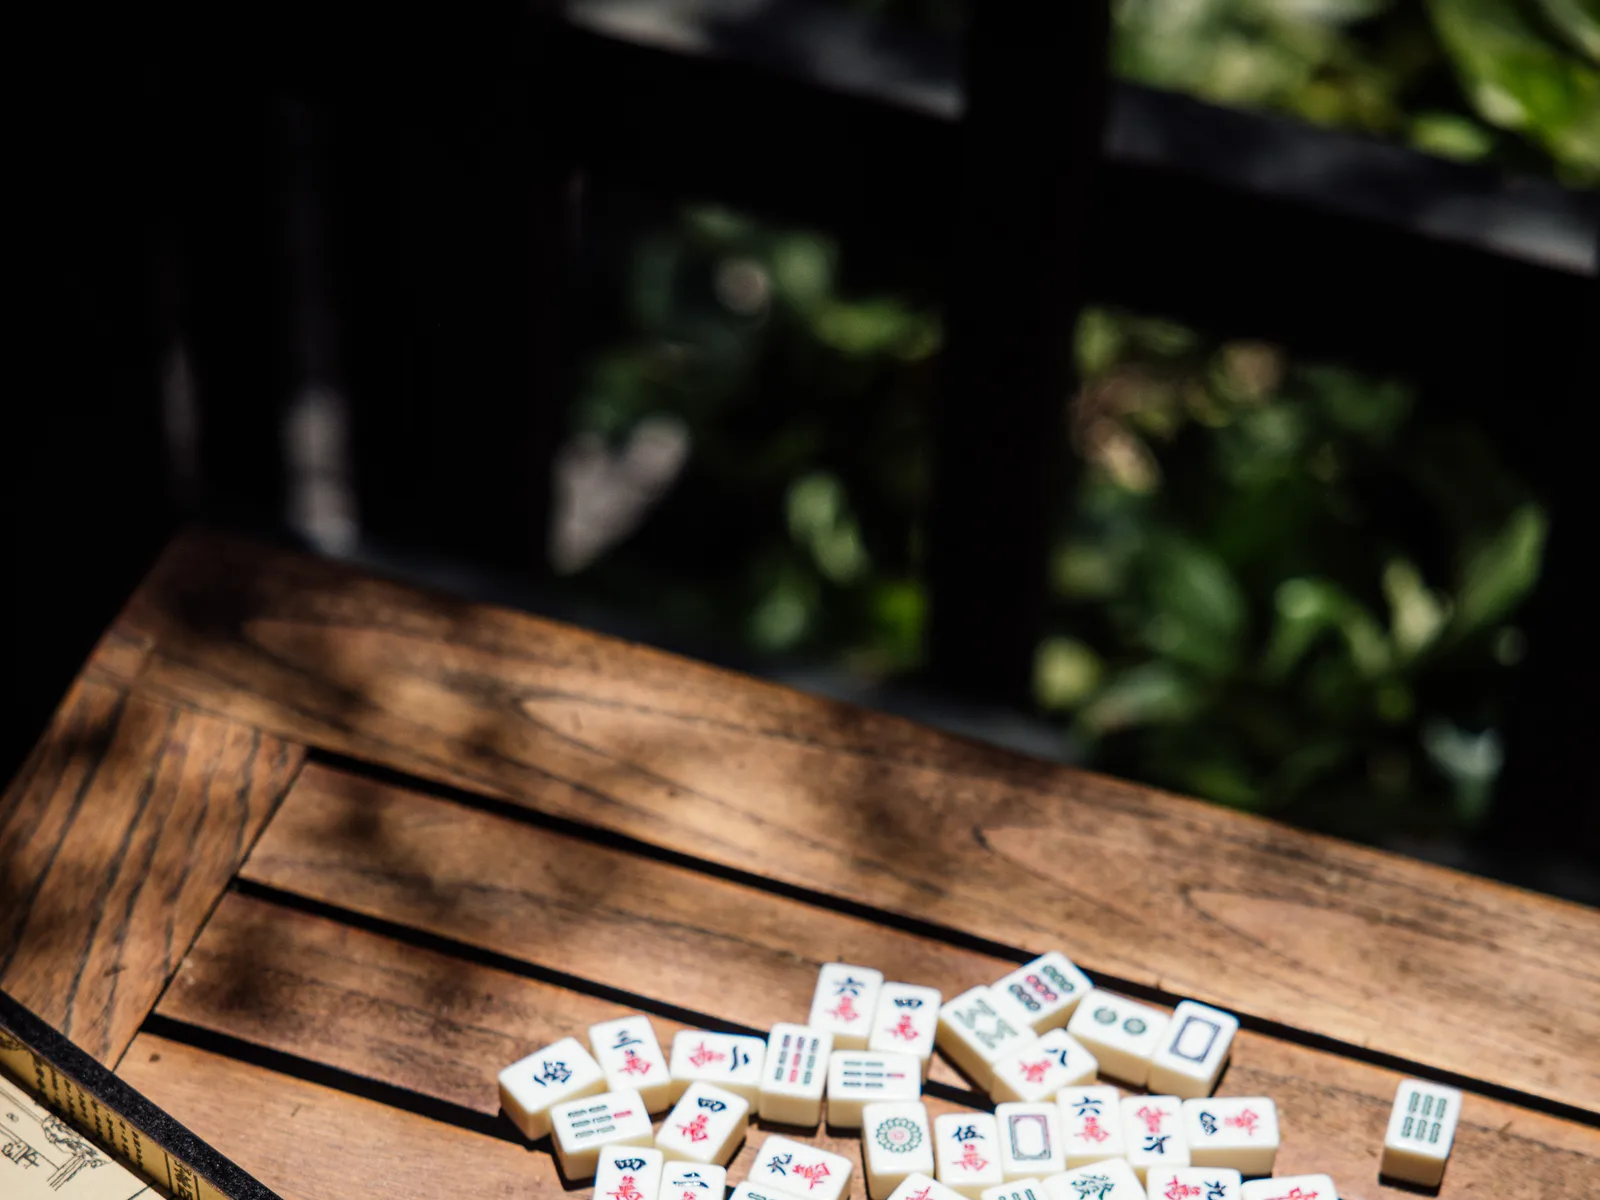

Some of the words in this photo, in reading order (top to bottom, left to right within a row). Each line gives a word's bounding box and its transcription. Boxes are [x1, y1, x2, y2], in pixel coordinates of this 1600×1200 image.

[825, 977, 865, 1022] 六萬
[612, 1029, 652, 1075] 三萬
[676, 1097, 727, 1142] 四萬
[1072, 1096, 1110, 1143] 六萬
